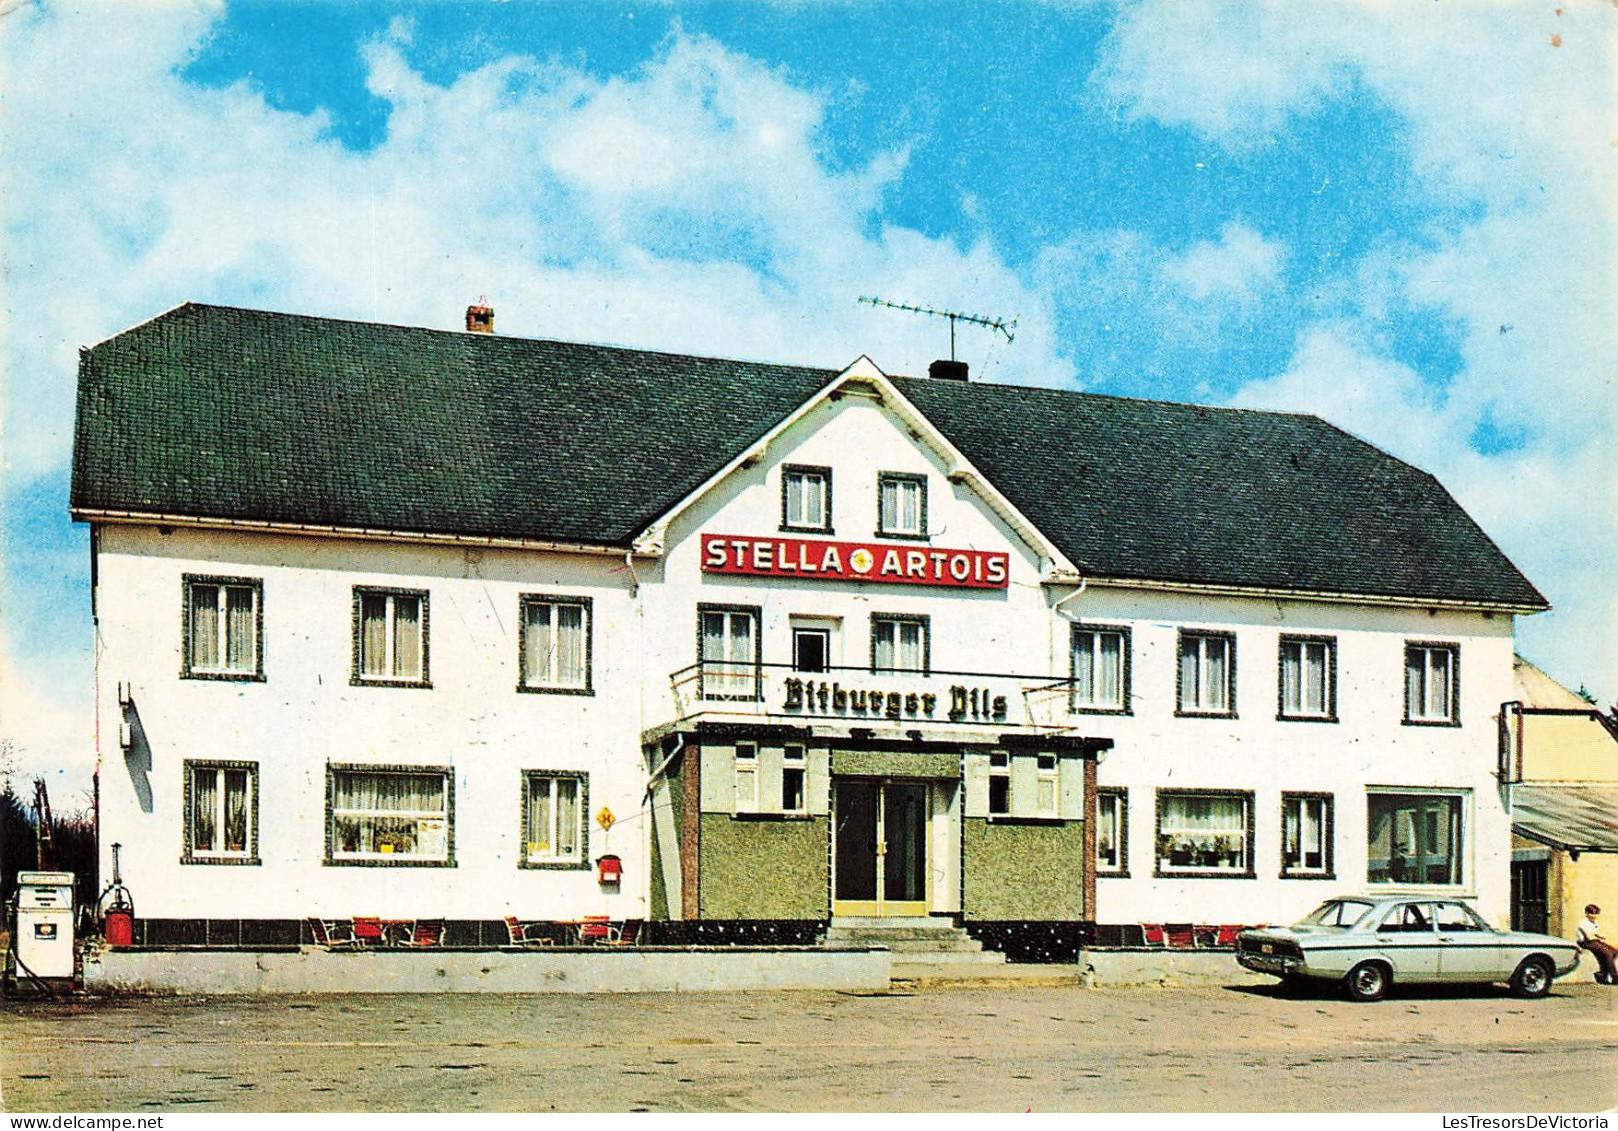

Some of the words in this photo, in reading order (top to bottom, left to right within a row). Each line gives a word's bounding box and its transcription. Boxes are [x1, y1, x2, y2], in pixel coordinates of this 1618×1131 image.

[705, 538, 843, 573] STELLA
[880, 549, 1007, 583] ARTOIS
[783, 677, 937, 719] Bitburger
[948, 684, 1008, 721] Pils
